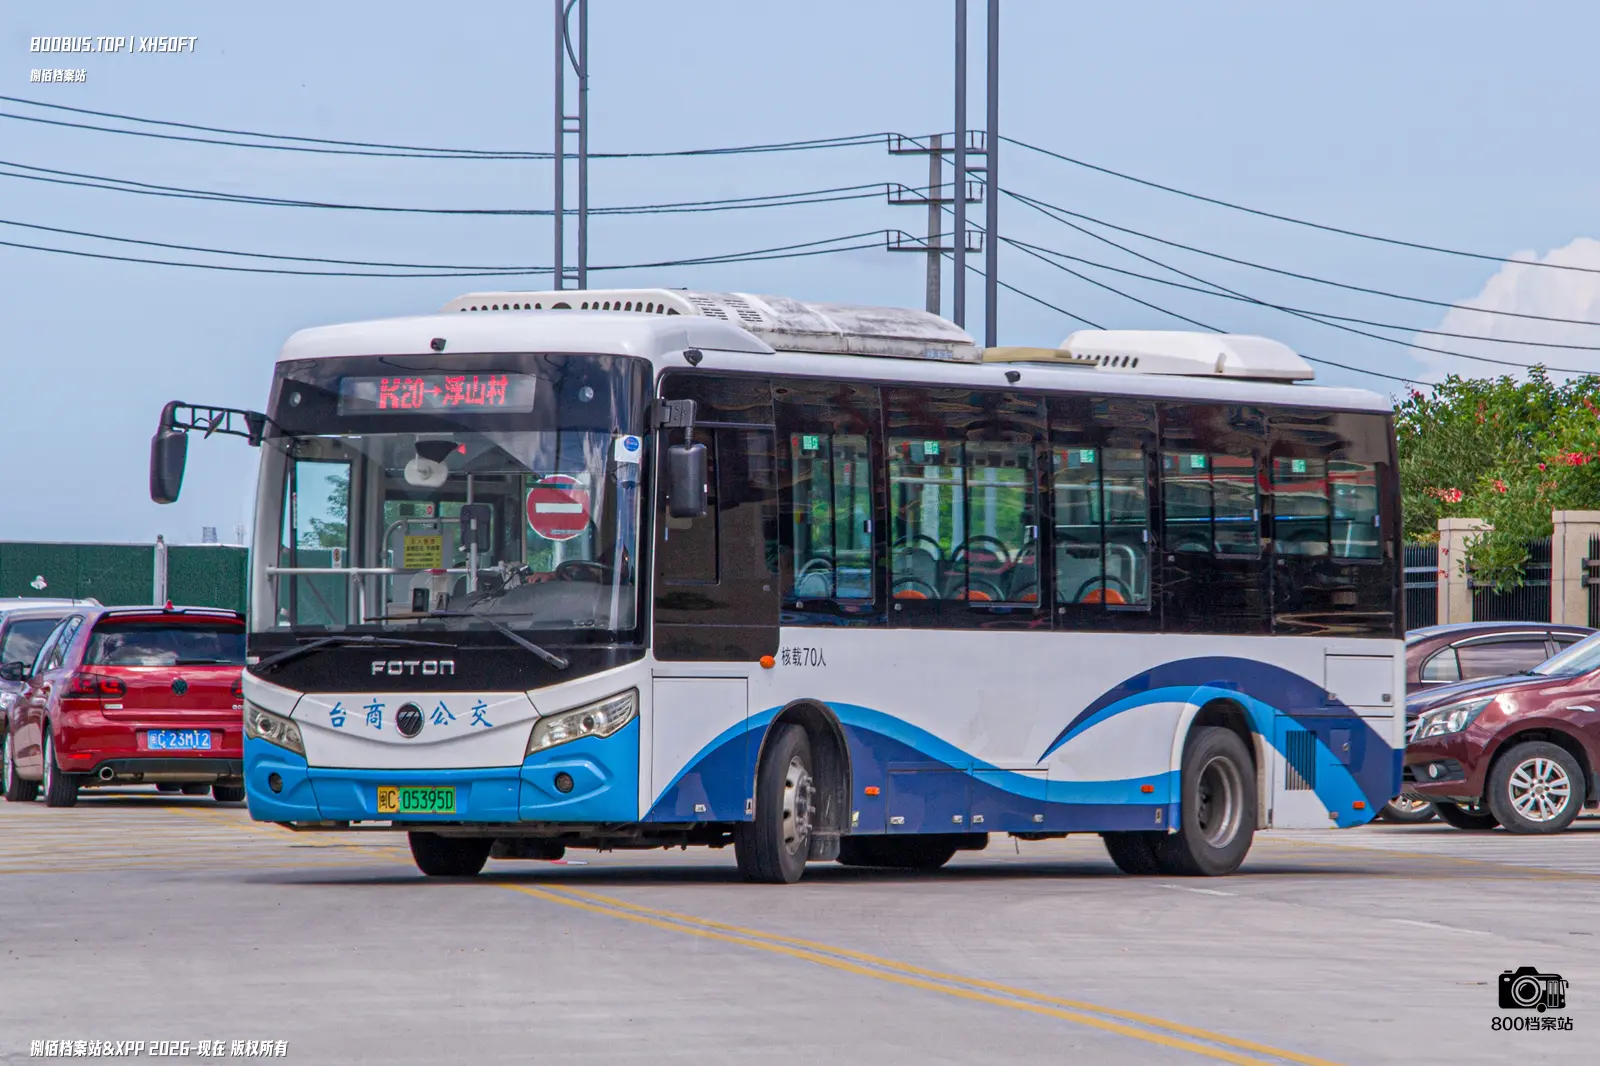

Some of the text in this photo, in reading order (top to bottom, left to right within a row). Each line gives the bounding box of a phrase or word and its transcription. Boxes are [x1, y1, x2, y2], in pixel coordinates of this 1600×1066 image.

[781, 646, 827, 667] 核载70人
[371, 660, 456, 676] FOTON
